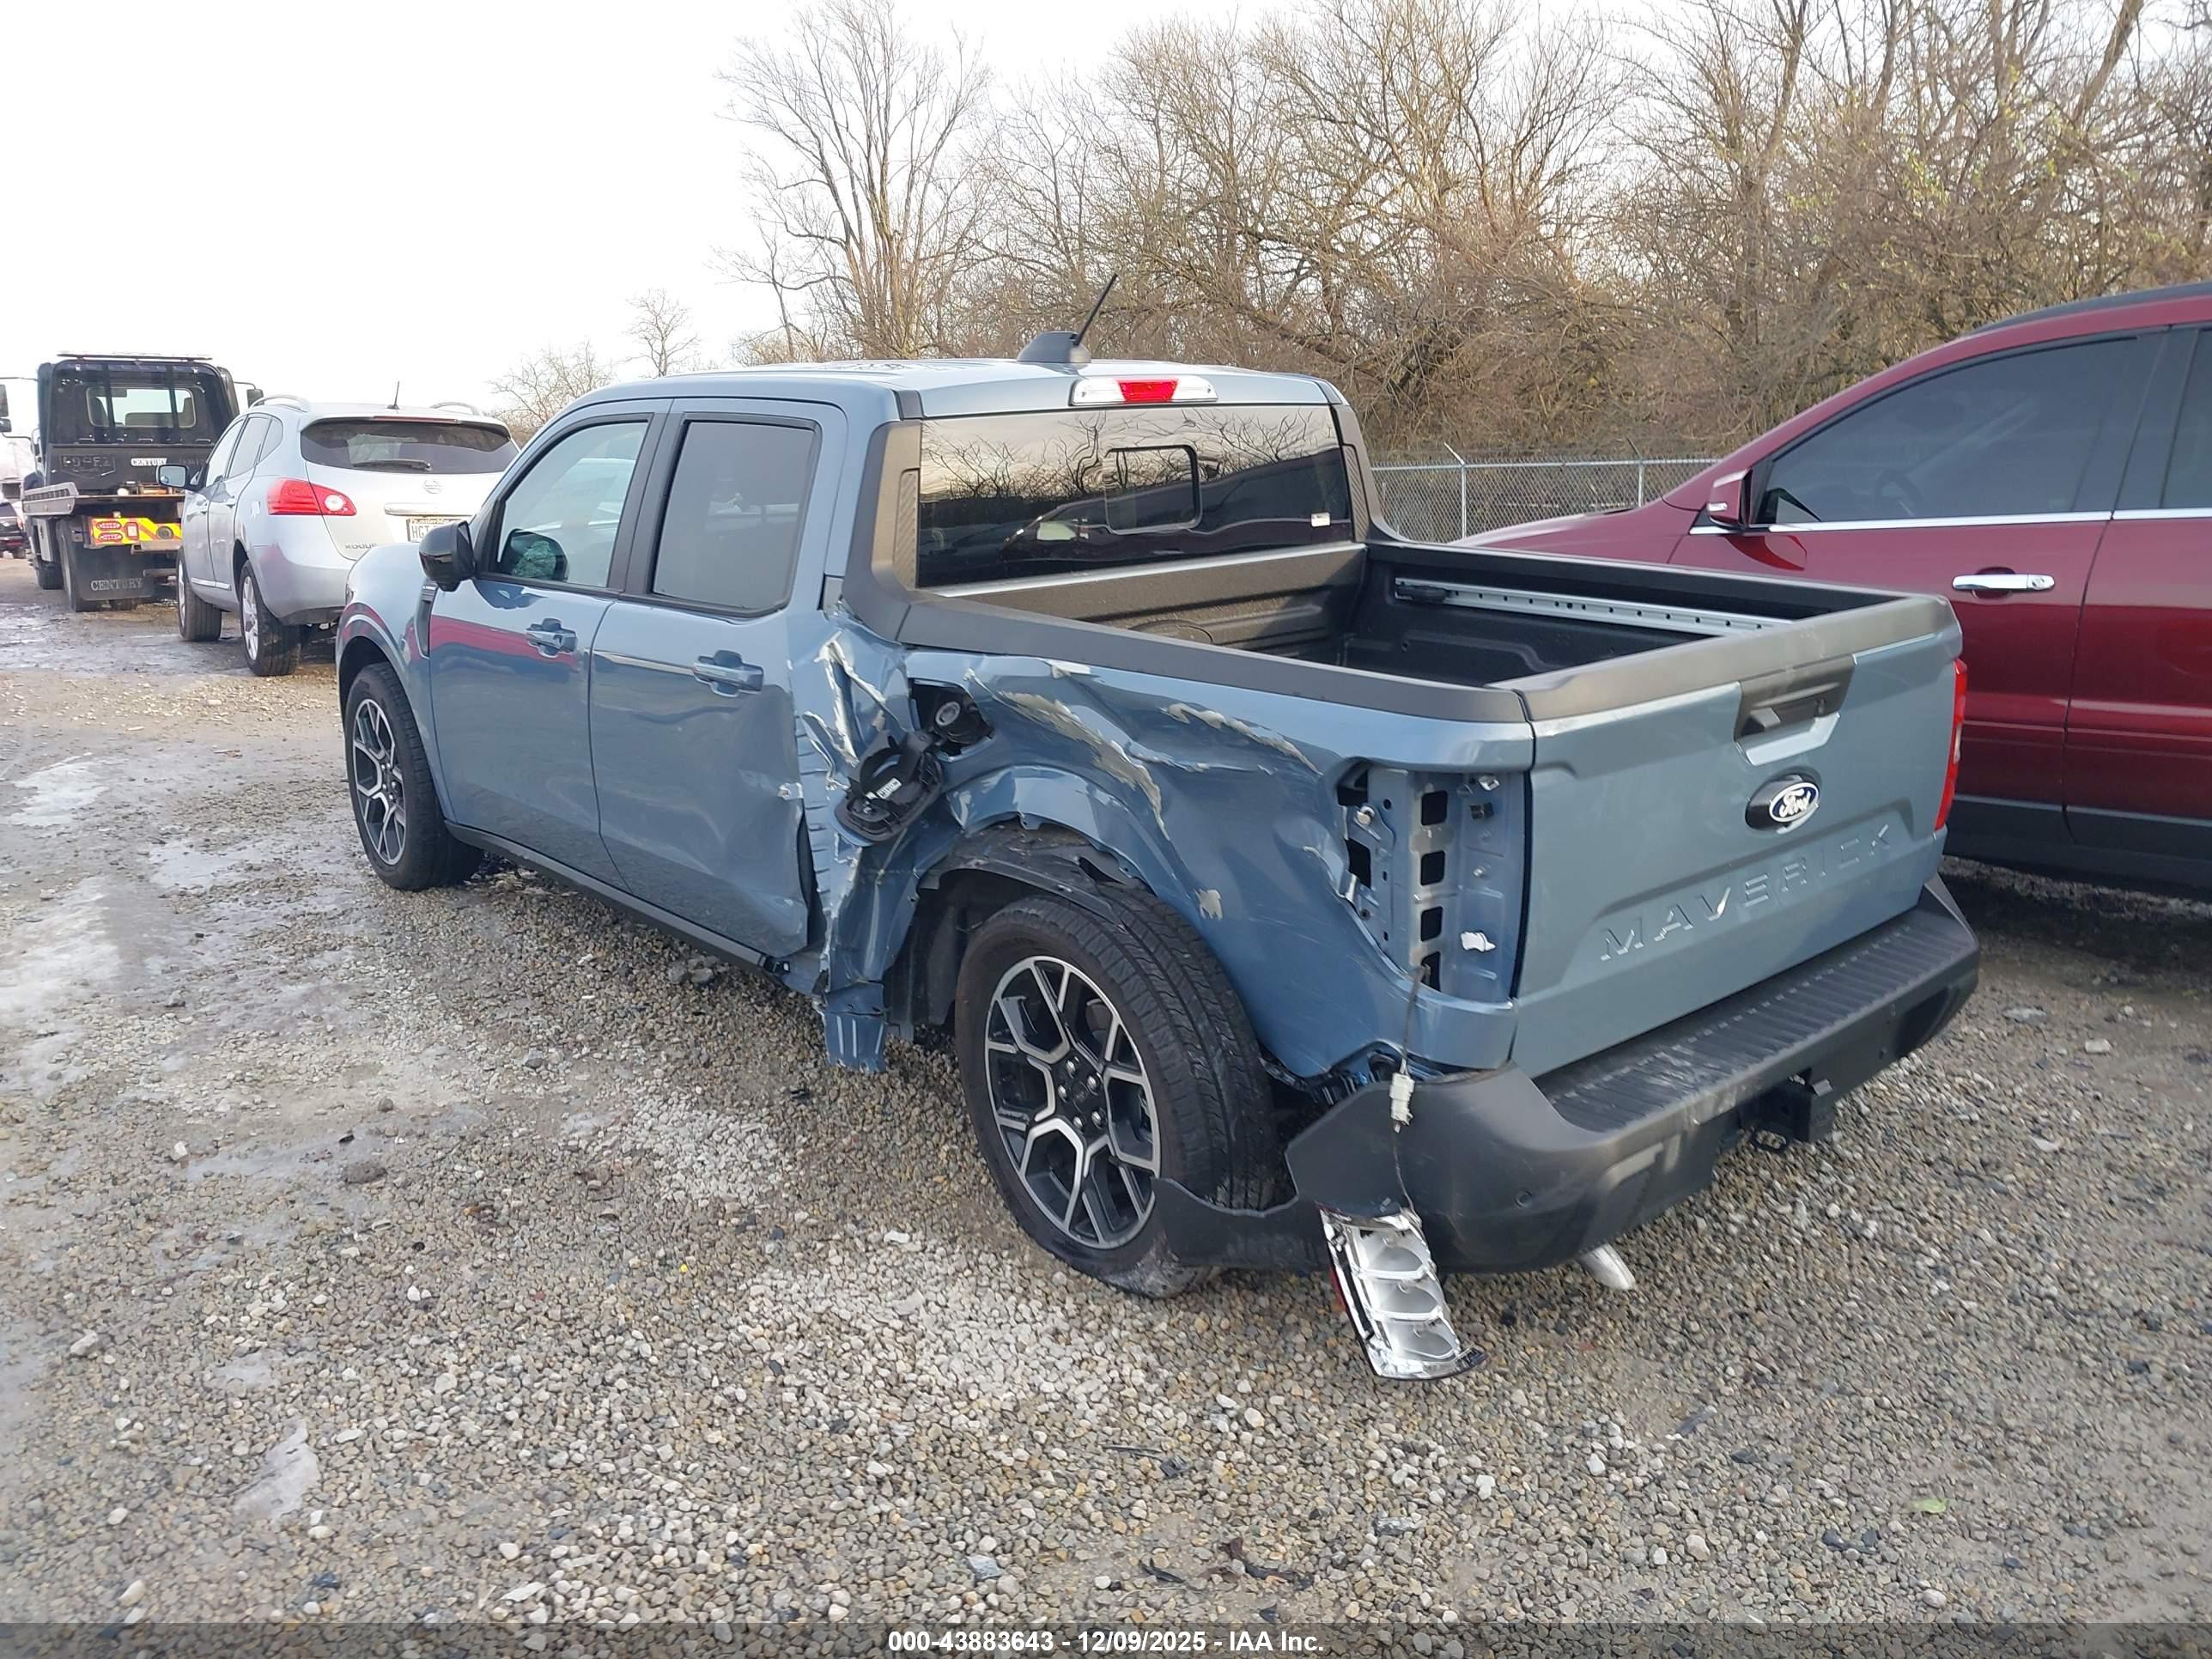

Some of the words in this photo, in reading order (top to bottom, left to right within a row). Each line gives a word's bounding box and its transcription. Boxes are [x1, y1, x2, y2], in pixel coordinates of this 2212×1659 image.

[131, 458, 167, 466] CENTURY
[90, 578, 143, 591] CENTURY
[1601, 823, 1891, 962] MAVERICK
